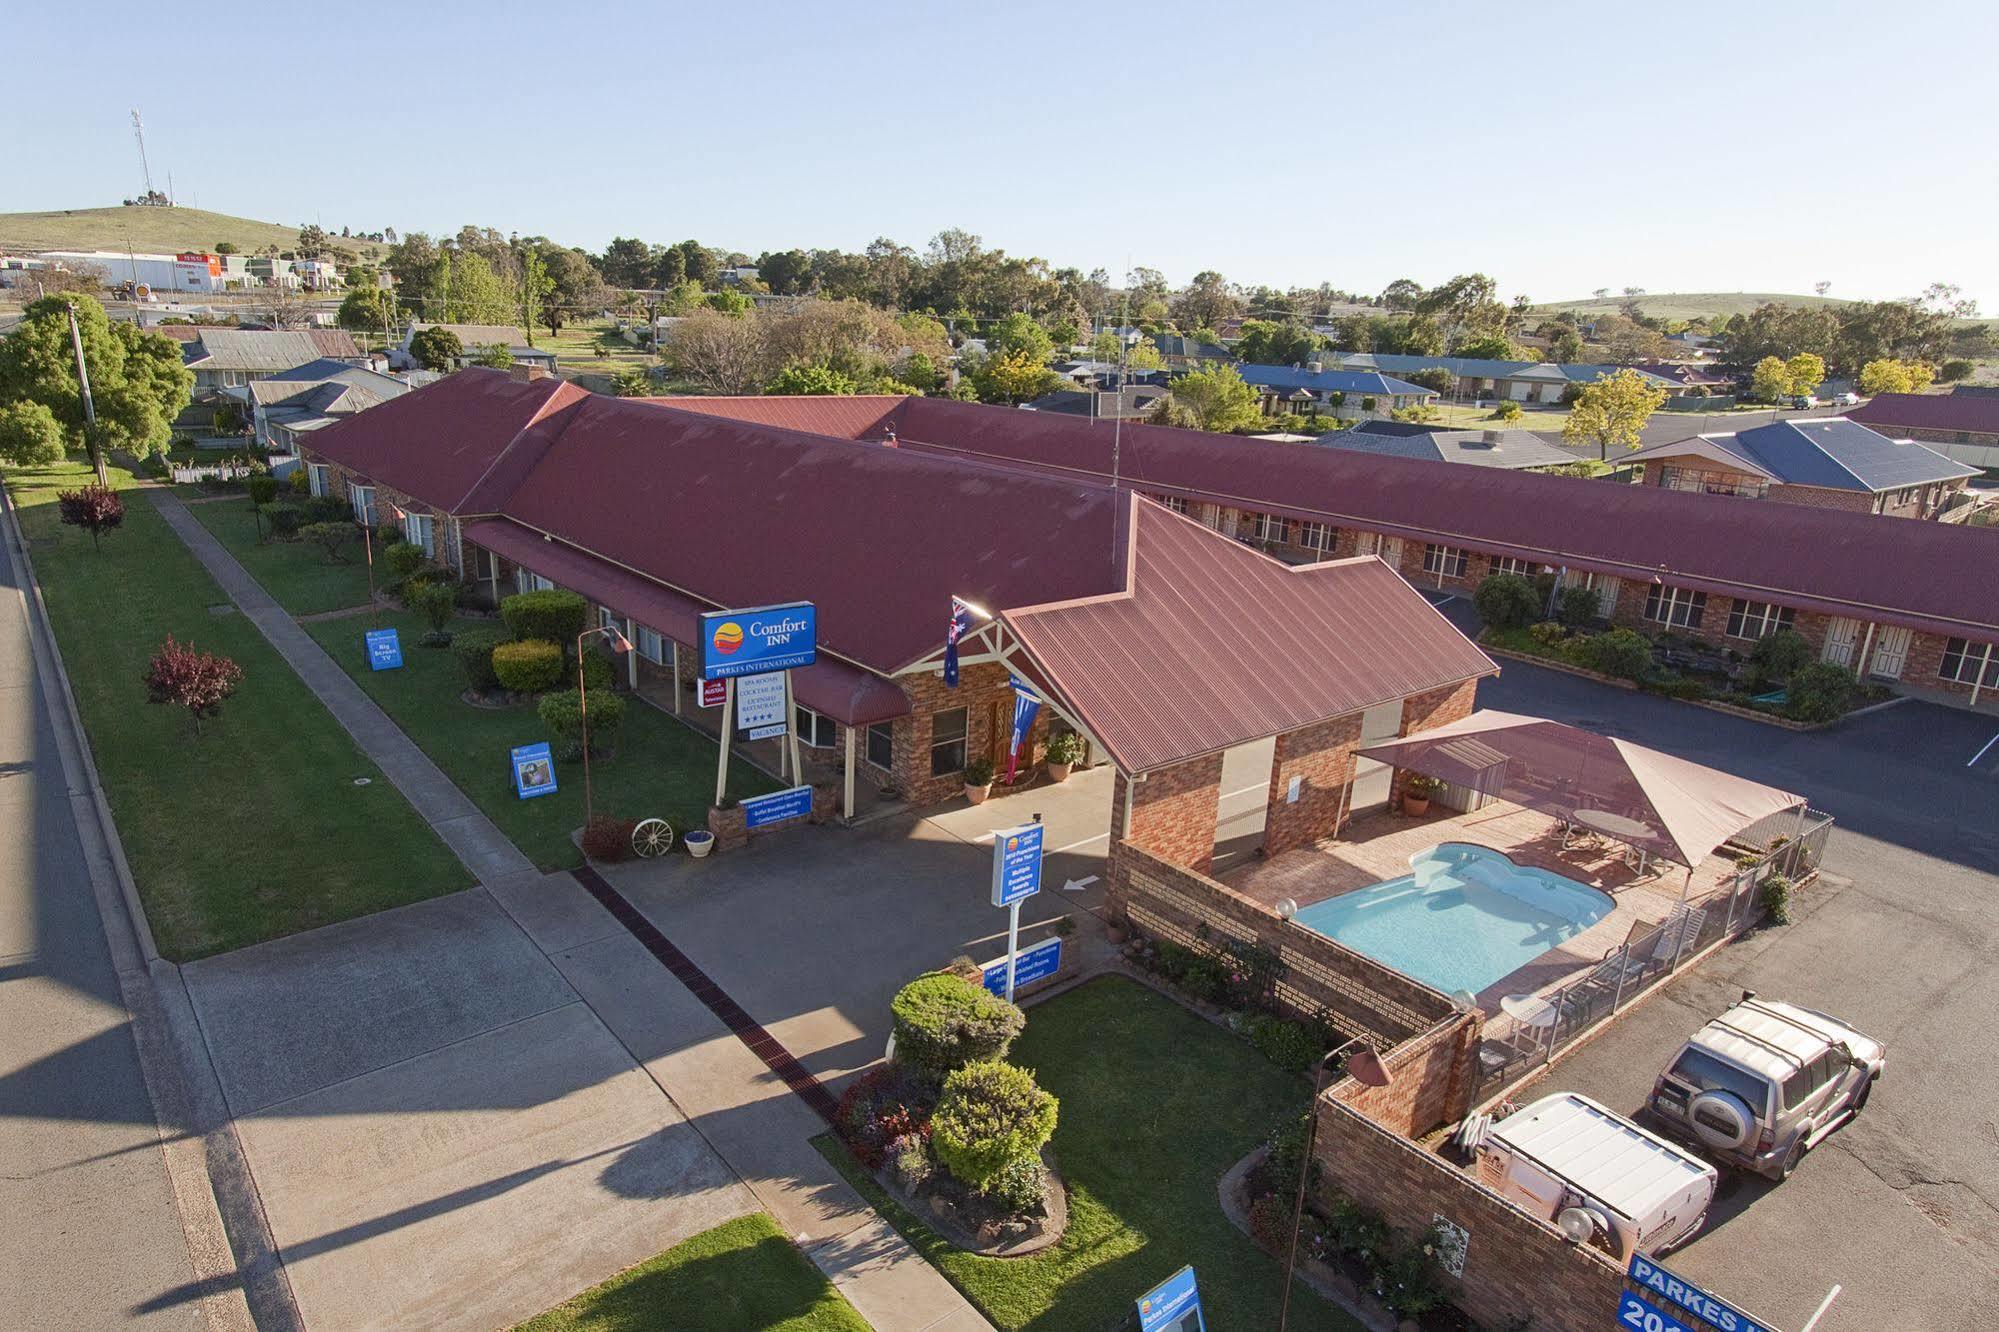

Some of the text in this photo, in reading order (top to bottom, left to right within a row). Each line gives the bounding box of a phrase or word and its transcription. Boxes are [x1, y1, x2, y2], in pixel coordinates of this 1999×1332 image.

[750, 617, 807, 637] Comfort
[767, 633, 790, 647] INN
[717, 656, 805, 676] PARKES INTERNATIONAL
[739, 687, 769, 697] COCKTAIL
[742, 701, 781, 712] RESTAURANT
[751, 727, 785, 738] VACANCY
[1634, 1260, 1738, 1331] PARKES
